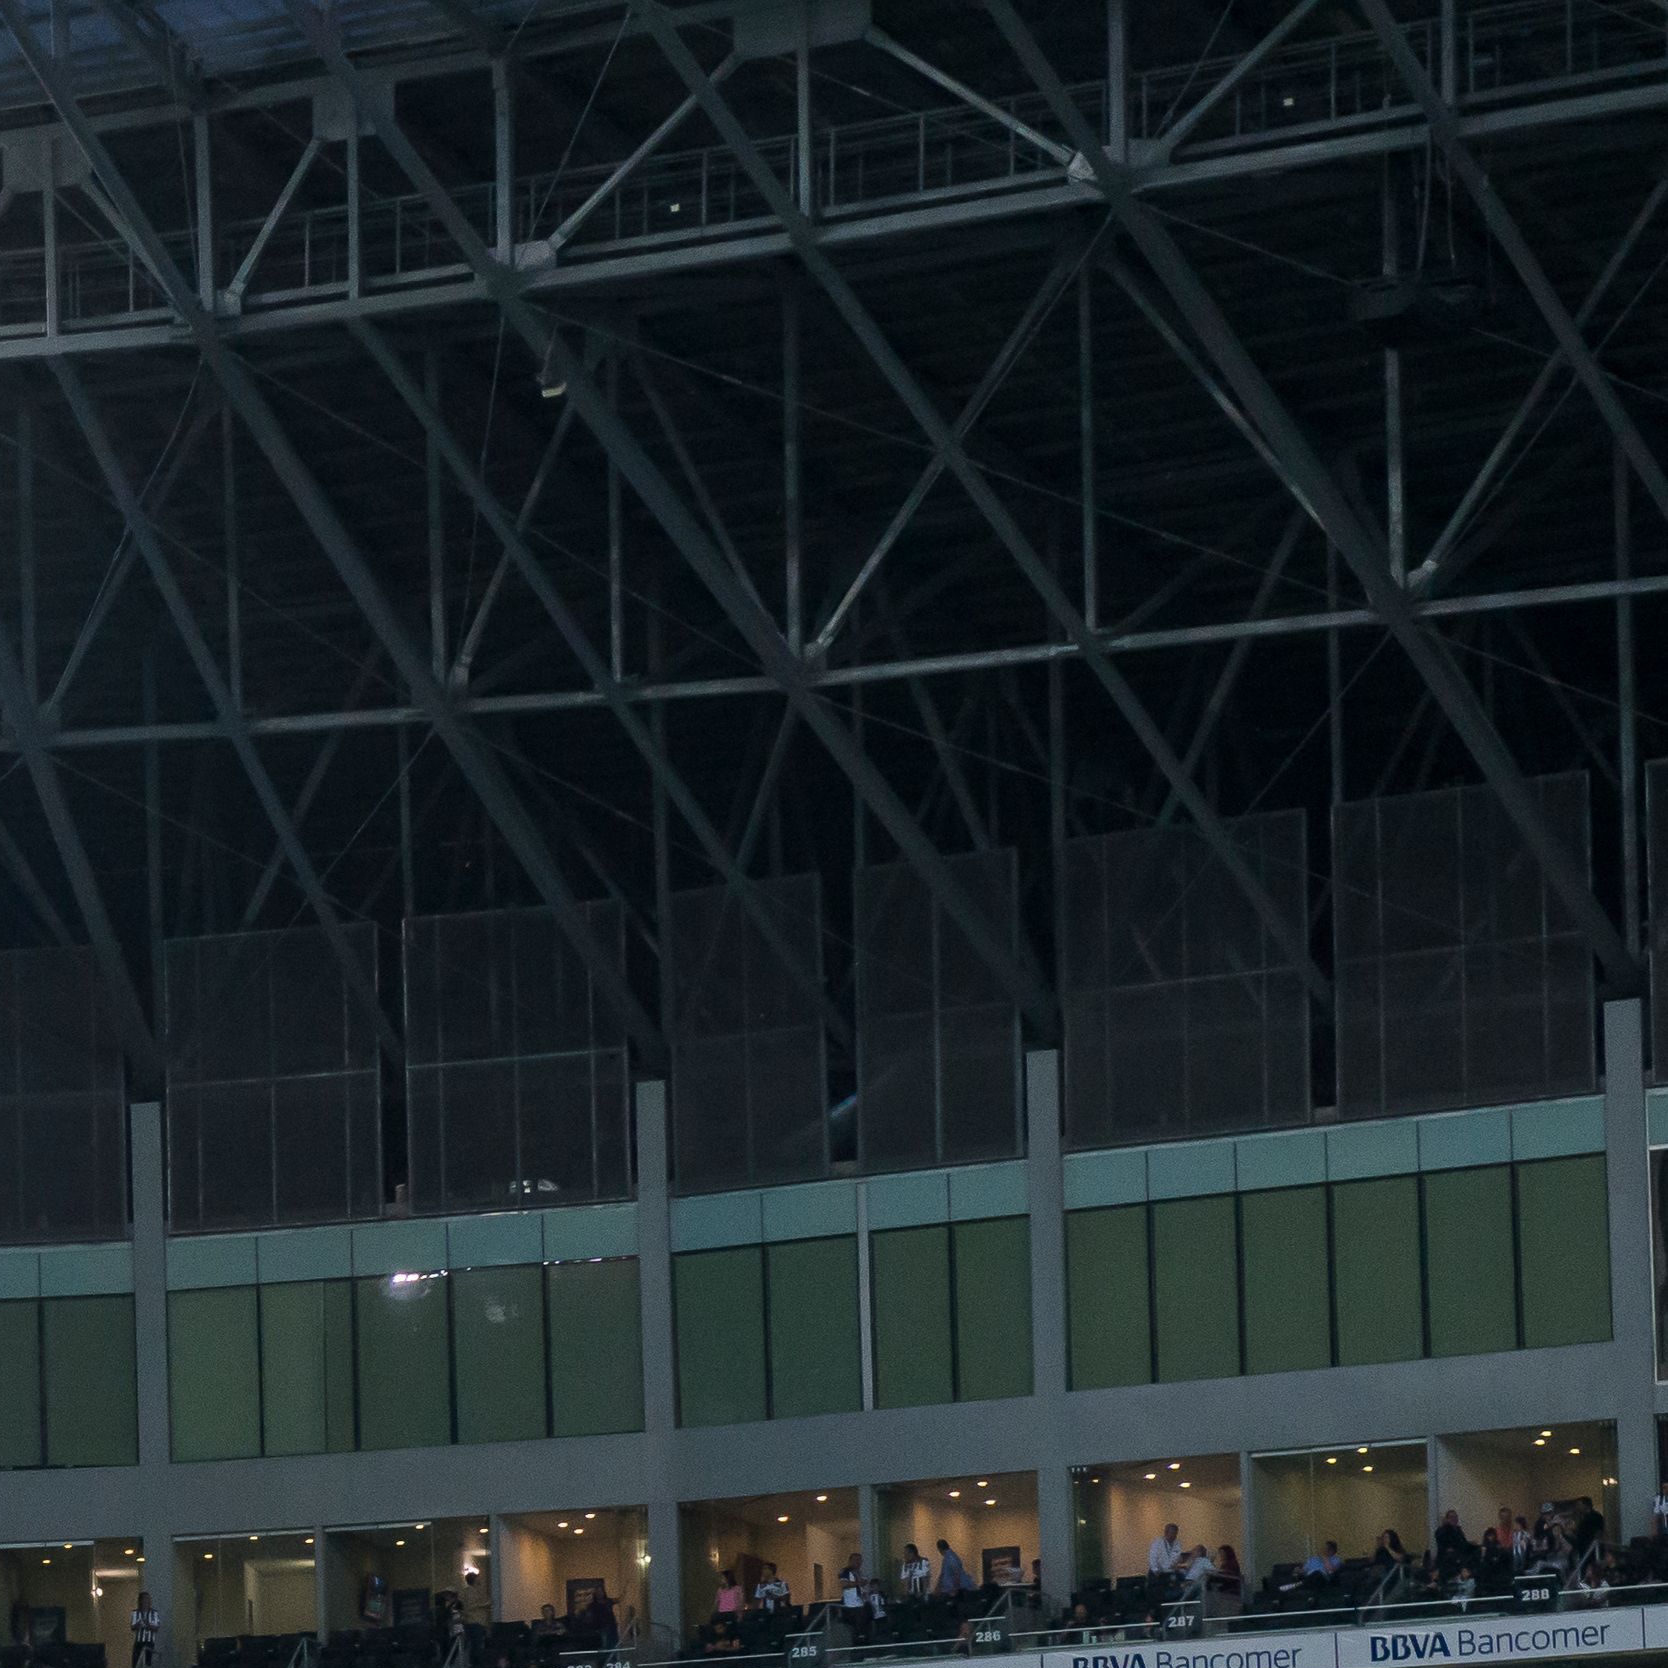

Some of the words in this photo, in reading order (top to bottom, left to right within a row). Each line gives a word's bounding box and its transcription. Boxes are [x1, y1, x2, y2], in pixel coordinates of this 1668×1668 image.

[1521, 1588, 1550, 1602] 288
[1167, 1615, 1195, 1628] 287
[1370, 1631, 1451, 1662] BBVA
[1457, 1624, 1611, 1657] Bancomer
